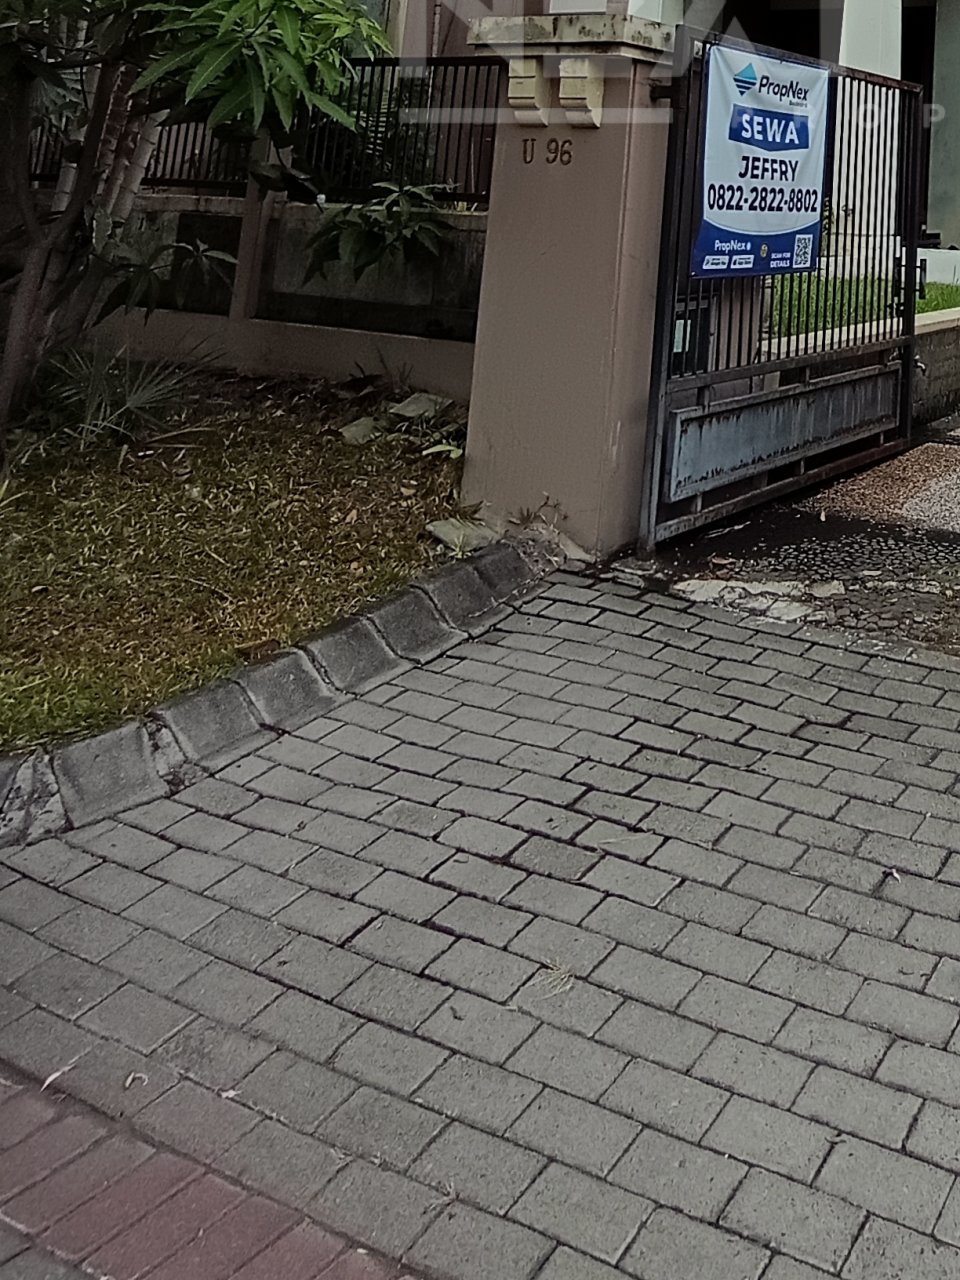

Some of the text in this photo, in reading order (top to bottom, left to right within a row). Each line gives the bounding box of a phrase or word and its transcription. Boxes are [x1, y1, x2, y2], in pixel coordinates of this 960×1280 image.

[757, 74, 809, 102] PropNex
[741, 114, 799, 144] SEWA
[522, 137, 573, 166] U 96
[738, 155, 799, 181] JEFFRY
[707, 183, 818, 213] 0822-2822-8802
[714, 239, 746, 253] PropNex
[769, 260, 790, 268] DETAILS
